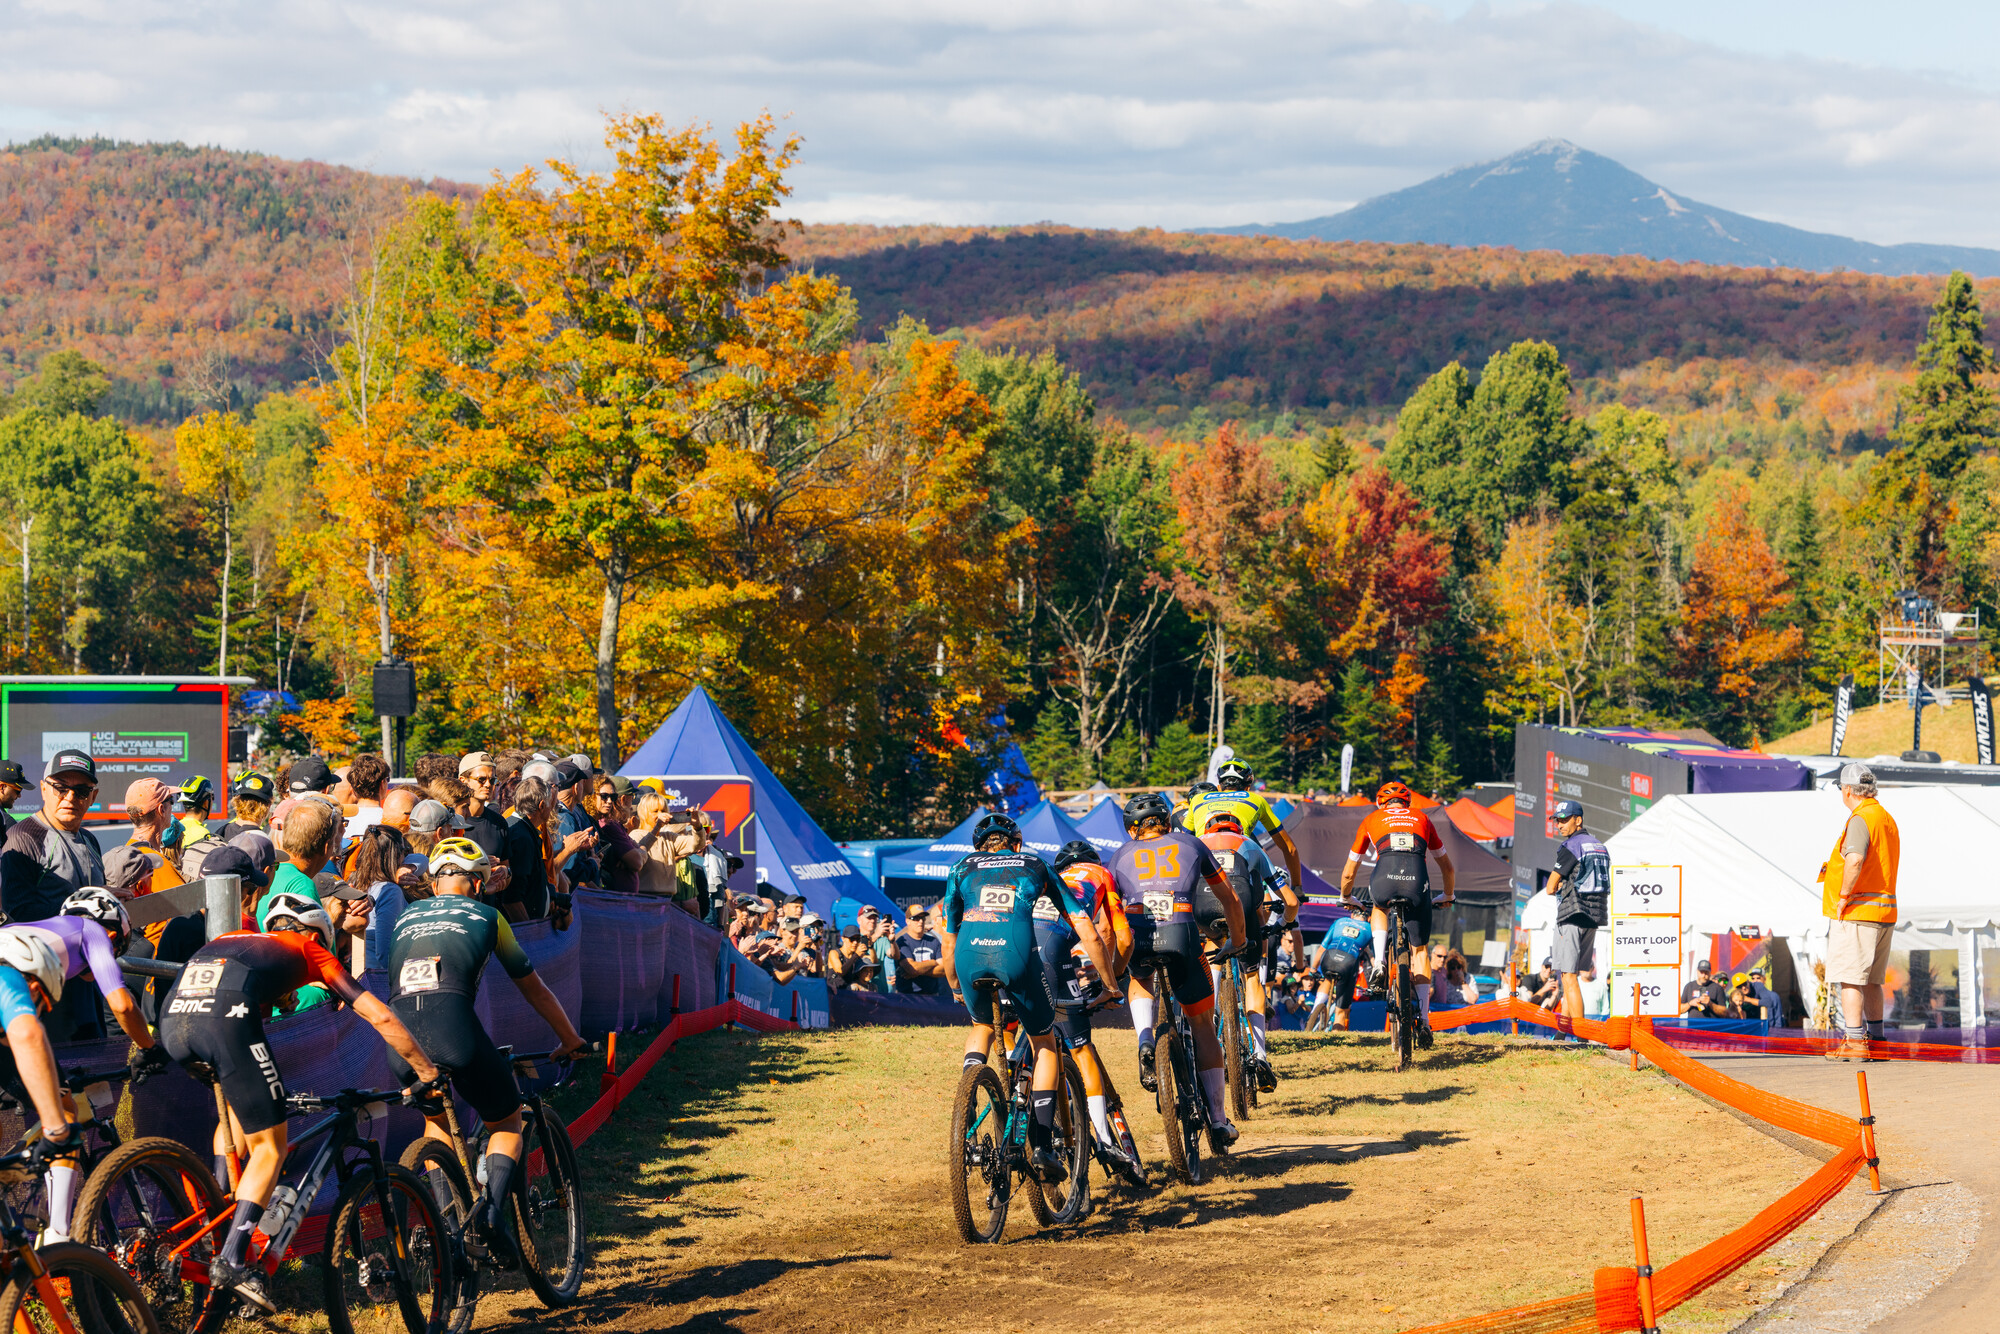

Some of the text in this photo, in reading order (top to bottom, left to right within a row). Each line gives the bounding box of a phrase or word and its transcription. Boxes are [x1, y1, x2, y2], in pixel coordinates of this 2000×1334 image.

[97, 732, 115, 741] UCI
[93, 740, 183, 748] MOUNTAIN BIKE
[93, 748, 183, 756] WORLD SERIES
[126, 765, 170, 773] PLACID
[1399, 838, 1406, 847] 5
[1133, 843, 1181, 881] 93
[791, 860, 851, 881] SHIMANO
[1387, 873, 1416, 881] HEIDEGGER
[1630, 884, 1663, 896] XCO
[985, 893, 1010, 904] 20
[1035, 900, 1056, 912] 32
[1147, 899, 1169, 913] 29
[393, 908, 488, 932] SCOTT
[977, 938, 1007, 946] vittoria
[1615, 936, 1677, 945] START LOOP
[189, 969, 215, 986] 19
[406, 963, 433, 982] 22
[168, 998, 216, 1014] BMC
[250, 1042, 285, 1100] BMC
